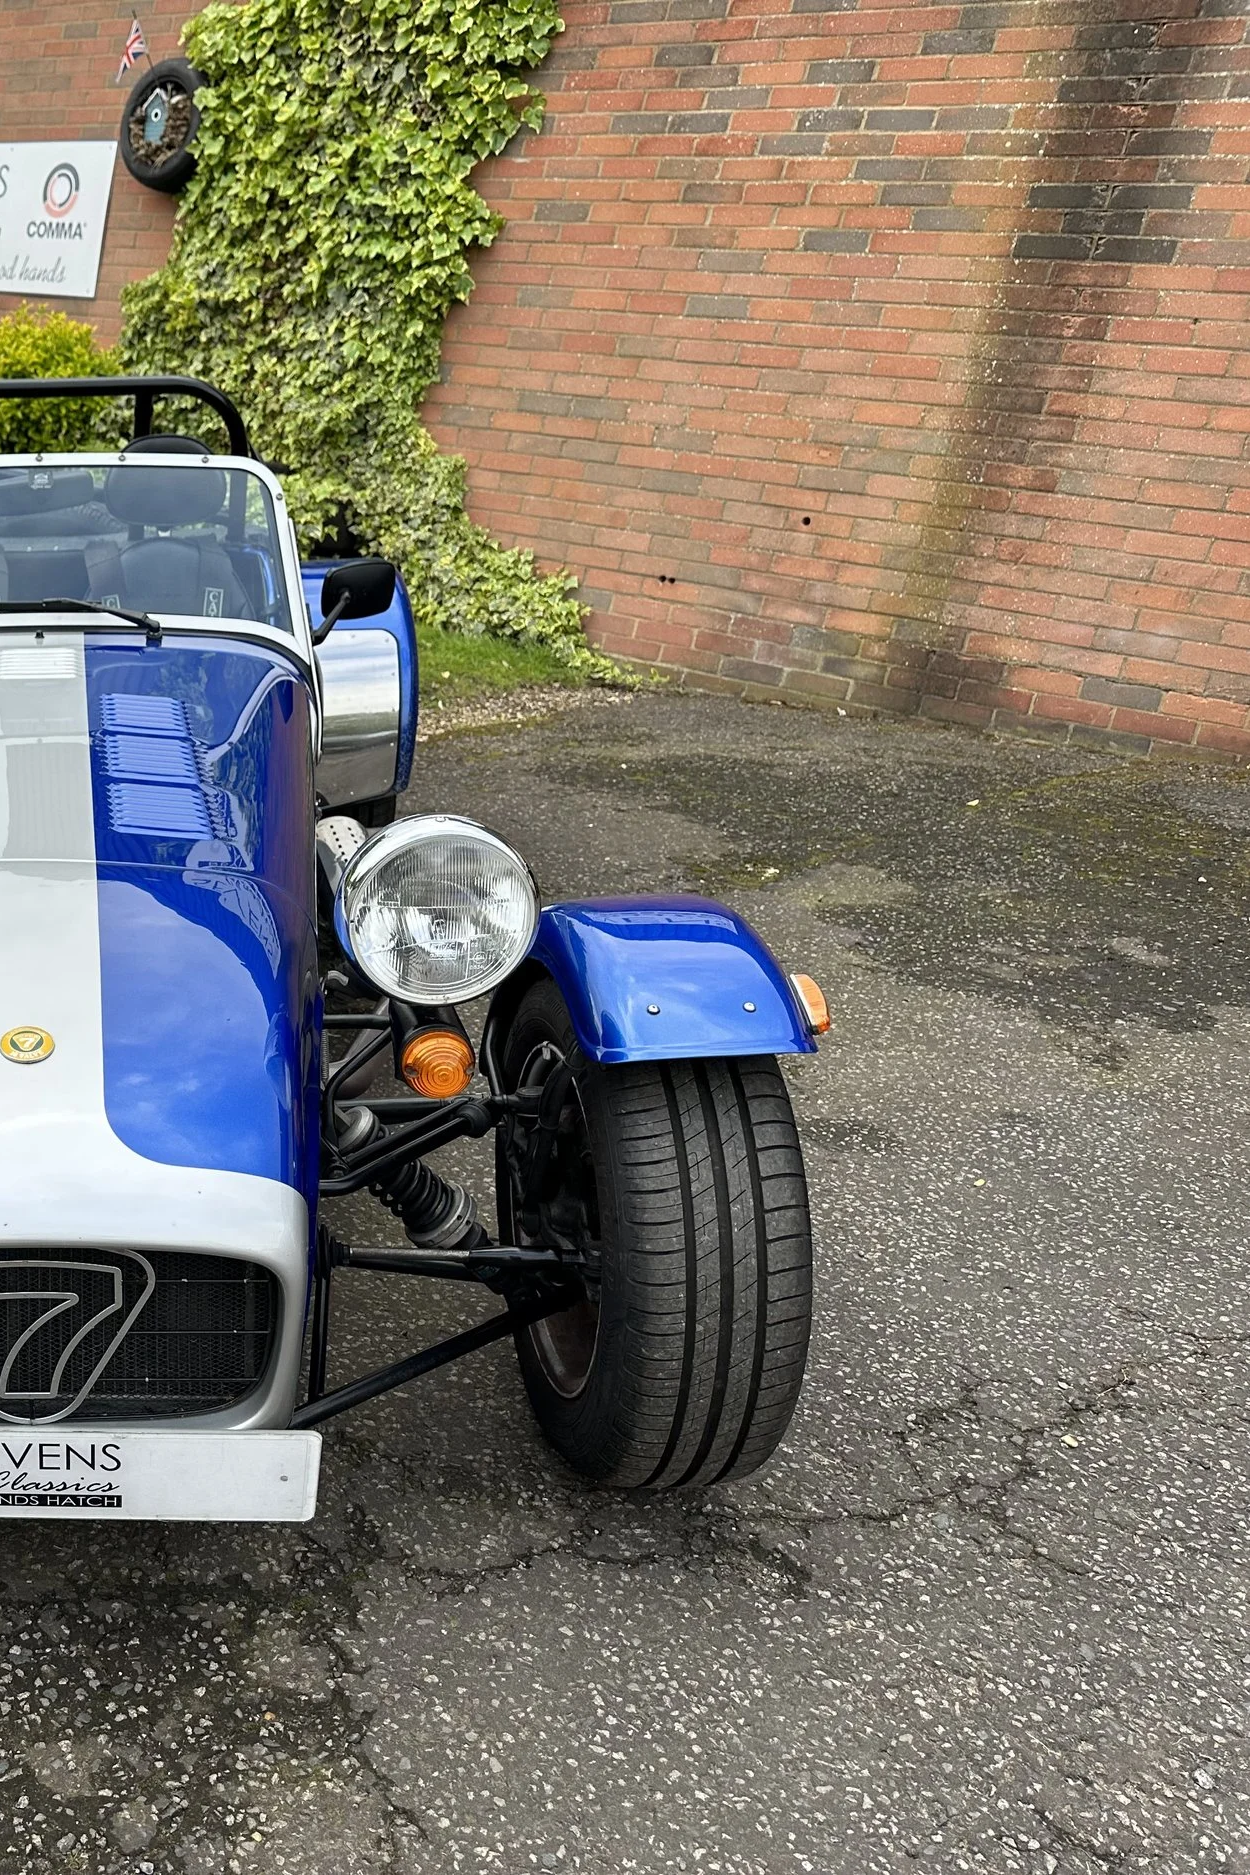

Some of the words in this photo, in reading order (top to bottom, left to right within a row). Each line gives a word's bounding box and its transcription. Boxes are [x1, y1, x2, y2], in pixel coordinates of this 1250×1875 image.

[26, 220, 83, 240] COMMA
[18, 254, 67, 284] hands
[46, 1496, 118, 1507] HATCH
